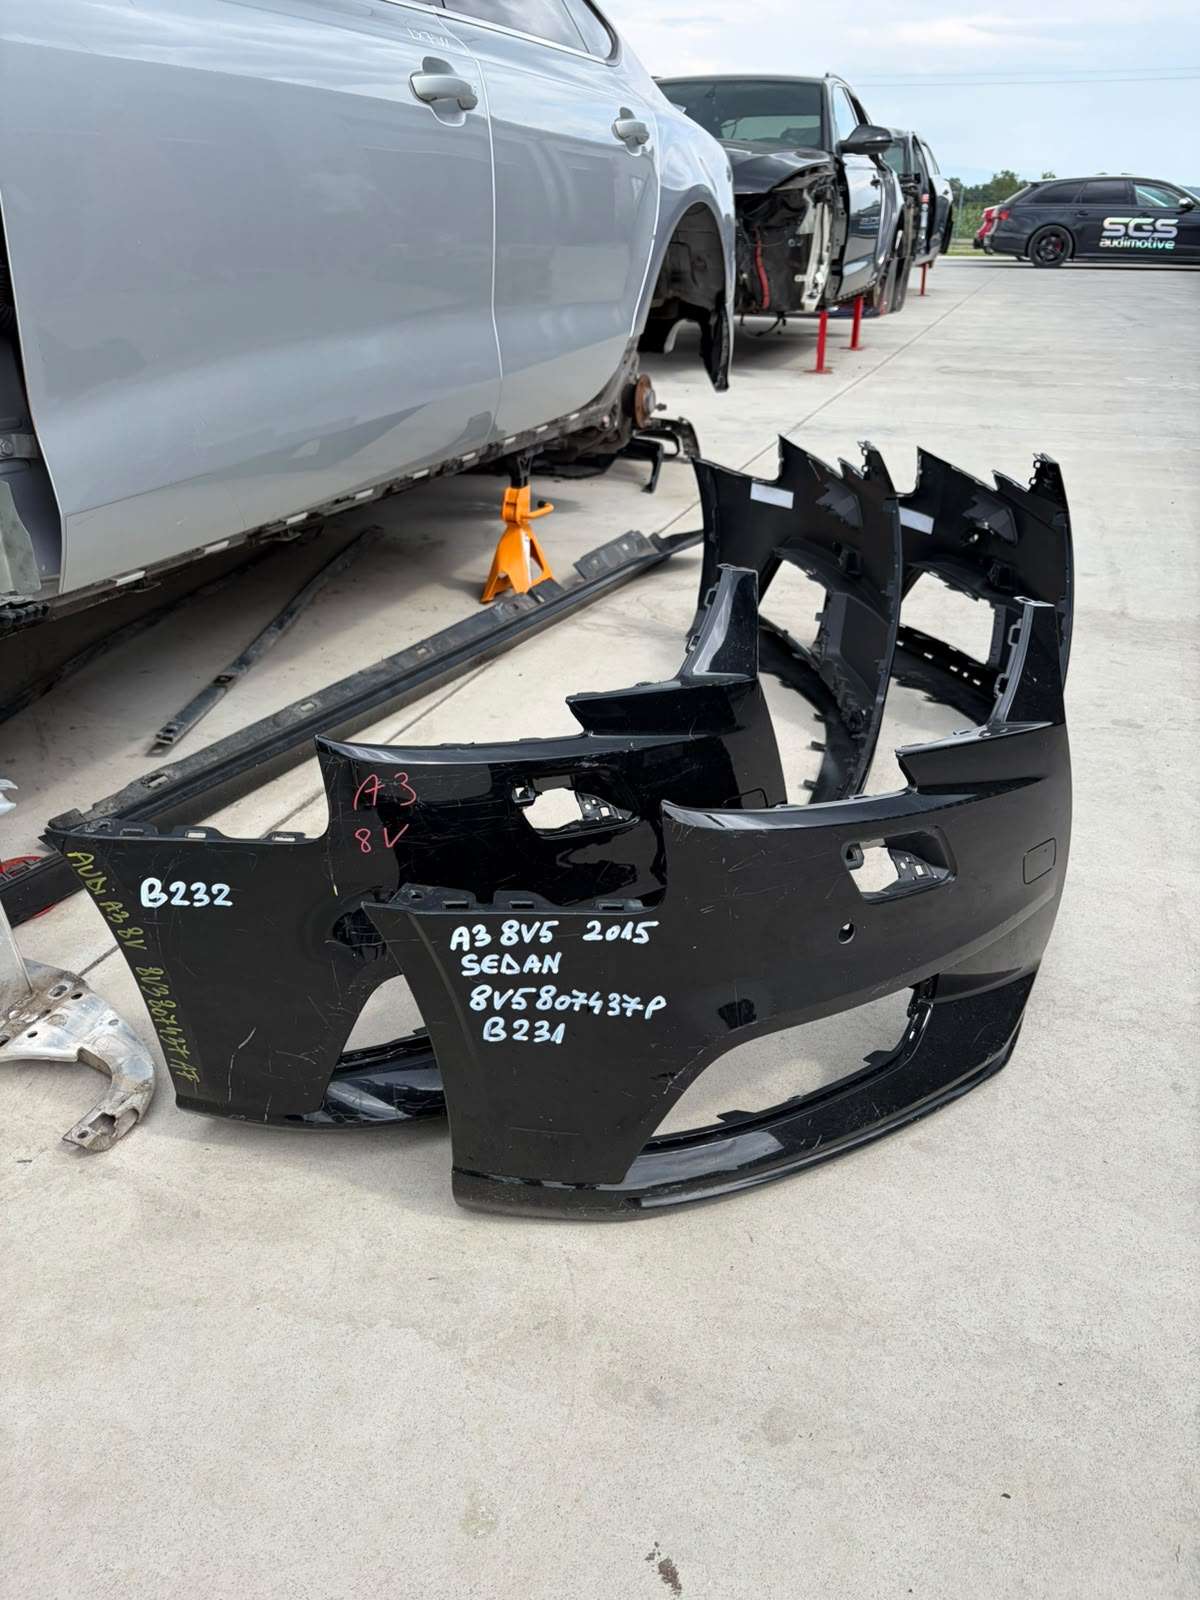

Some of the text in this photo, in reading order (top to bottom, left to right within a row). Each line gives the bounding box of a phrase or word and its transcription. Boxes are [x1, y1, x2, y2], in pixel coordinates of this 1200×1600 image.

[1099, 236, 1176, 250] audimotive
[352, 771, 417, 811] A3
[354, 823, 410, 854] 8V
[139, 877, 234, 908] B232
[99, 900, 130, 925] A3
[116, 926, 148, 951] 8V
[449, 919, 660, 951] A3 8V5 2015
[460, 951, 563, 977] SEDAN
[482, 1015, 566, 1045] B231
